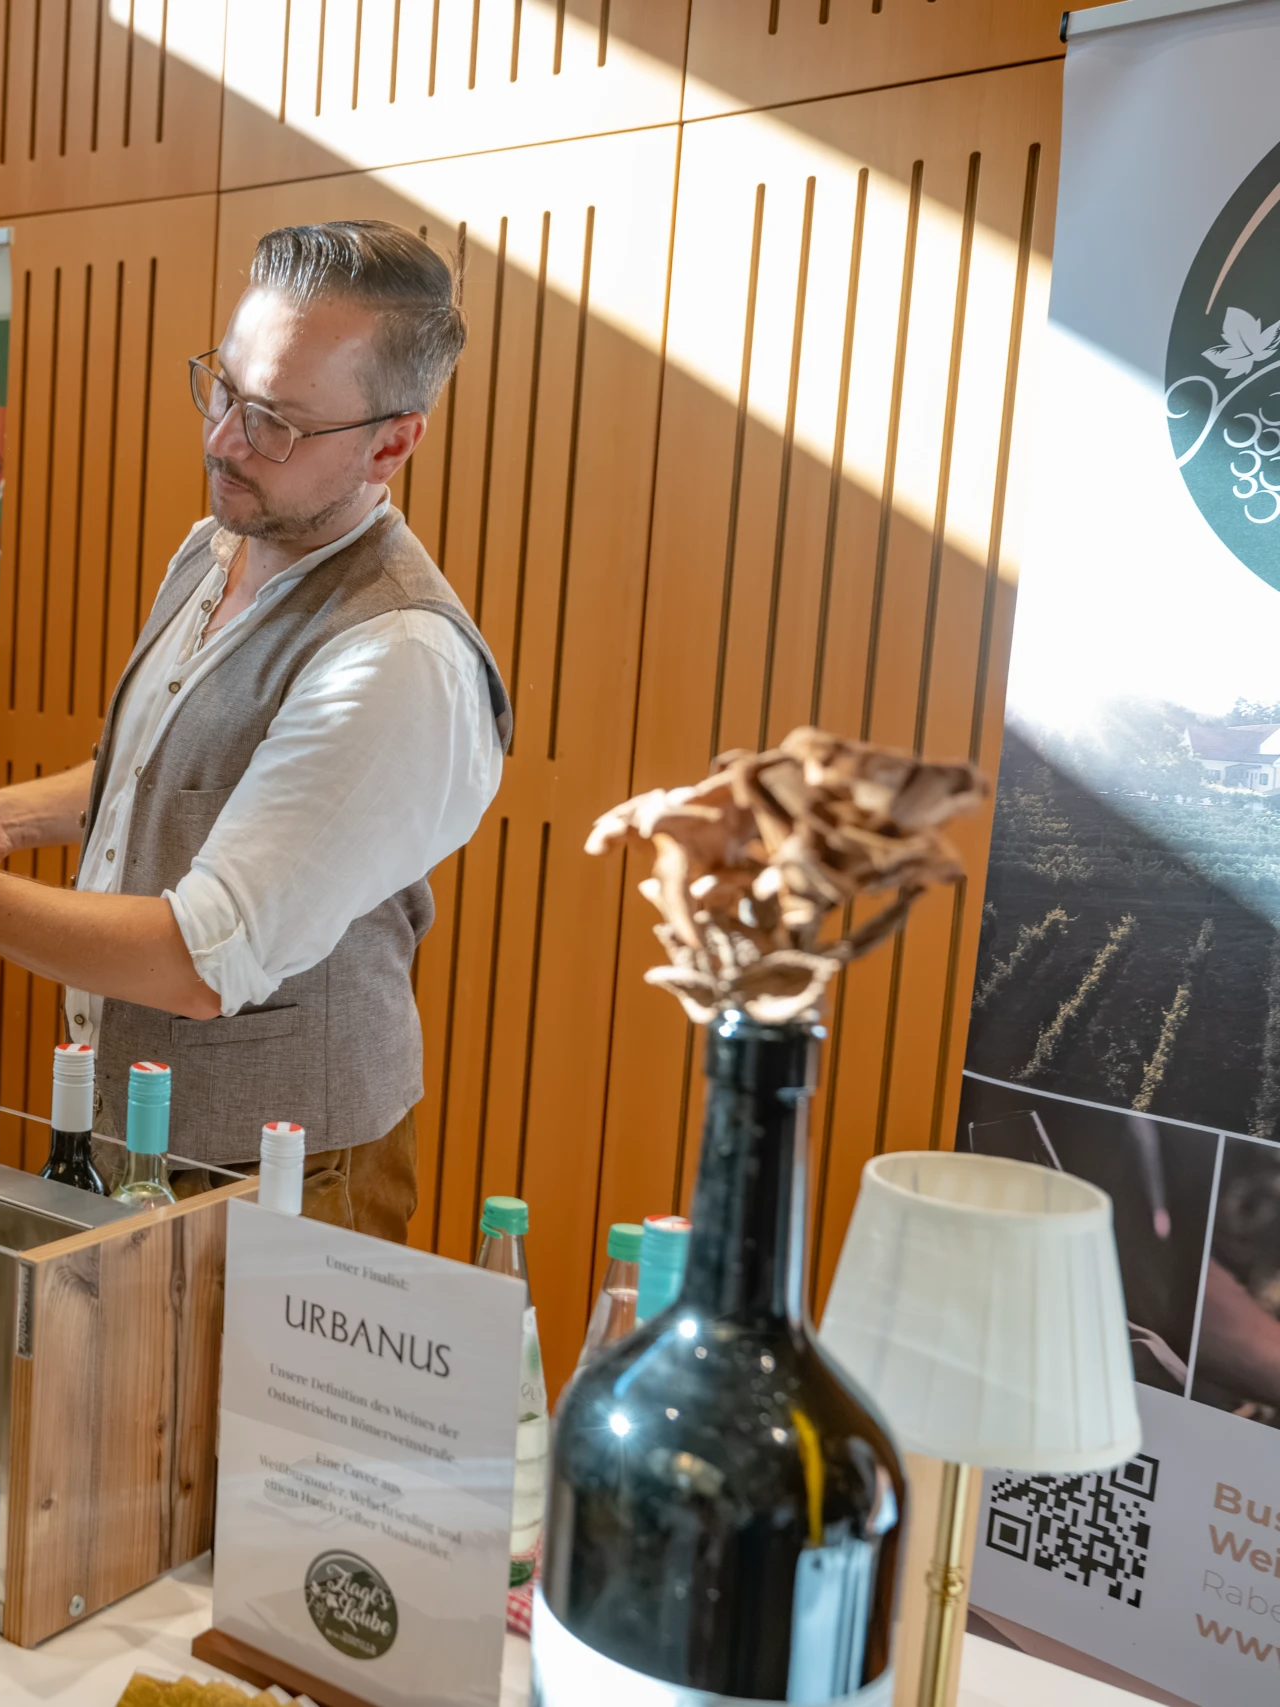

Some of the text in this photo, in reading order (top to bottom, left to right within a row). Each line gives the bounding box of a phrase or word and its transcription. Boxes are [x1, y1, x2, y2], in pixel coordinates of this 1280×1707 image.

[325, 1254, 410, 1292] Unser Finalist:
[285, 1294, 451, 1379] URBANUS
[267, 1385, 348, 1425] Oststeirischen
[270, 1362, 461, 1441] Unsere Definition des Weines der
[315, 1451, 341, 1472] Eine
